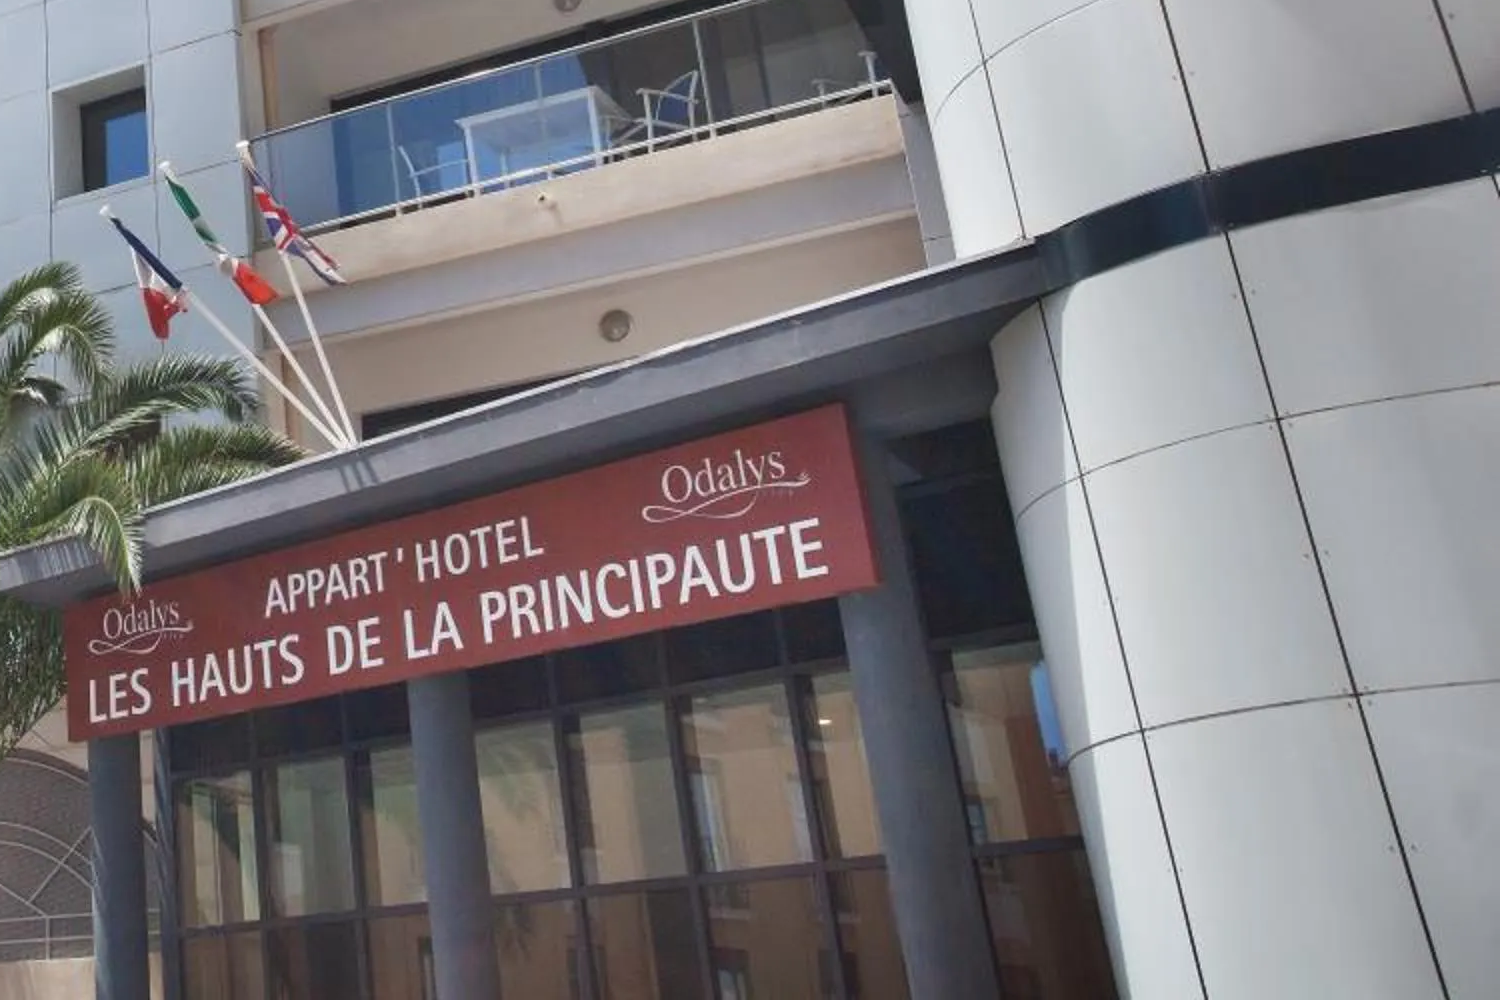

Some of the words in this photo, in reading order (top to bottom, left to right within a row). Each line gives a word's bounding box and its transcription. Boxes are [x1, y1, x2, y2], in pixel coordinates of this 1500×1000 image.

[661, 449, 786, 504] Odalys
[88, 667, 152, 724] LES
[171, 633, 305, 708] HAUTS
[326, 616, 384, 676] DE
[404, 601, 465, 661] LA
[479, 517, 830, 646] PRINCIPAUTE
[102, 599, 180, 640] Odalys
